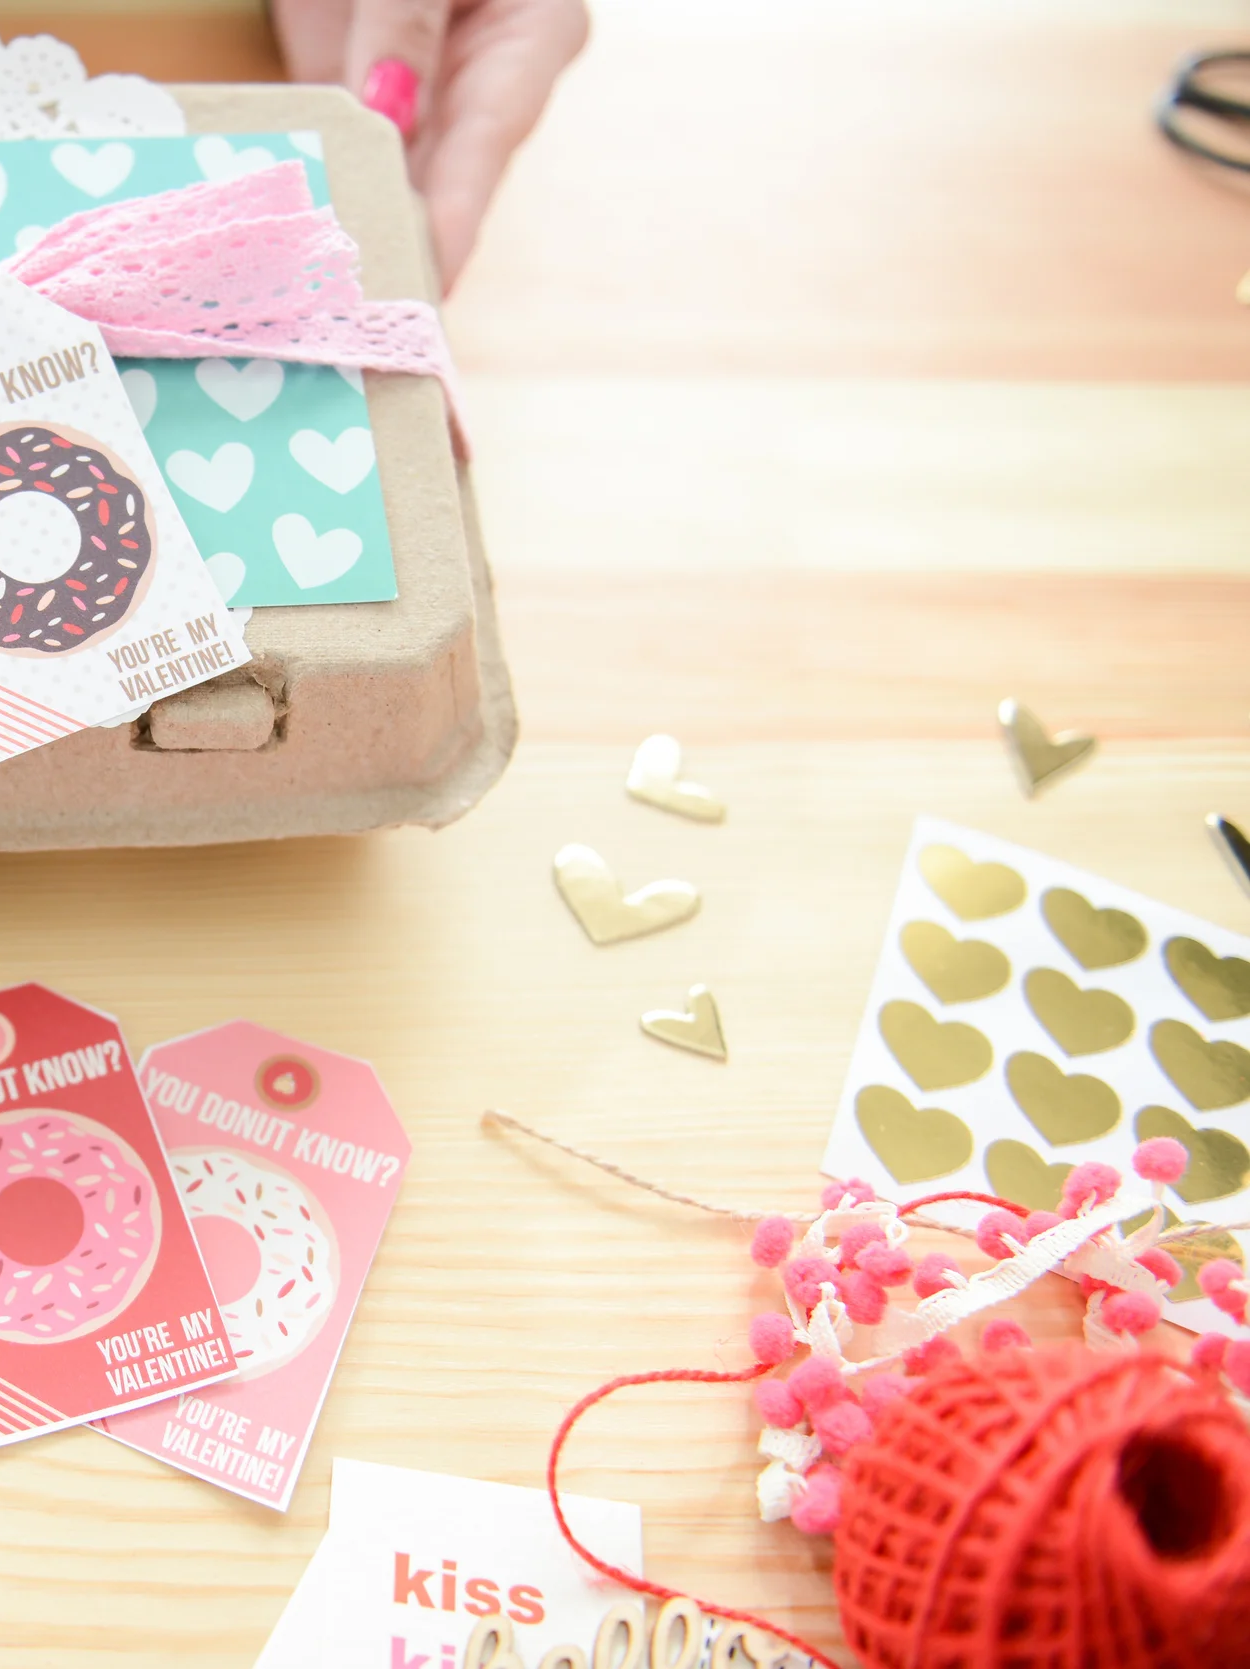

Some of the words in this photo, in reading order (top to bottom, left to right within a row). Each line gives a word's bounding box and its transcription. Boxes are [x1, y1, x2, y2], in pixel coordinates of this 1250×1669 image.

[106, 628, 181, 673] YOU'RE
[185, 613, 218, 645] MY
[118, 640, 235, 702] VALENTINE!
[21, 1039, 122, 1096] KNOW?
[146, 1067, 201, 1115] YOU
[197, 1091, 295, 1152] DONUT
[292, 1127, 400, 1188] KNOW?
[96, 1322, 174, 1365] YOU'RE
[179, 1308, 214, 1341] MY
[105, 1337, 230, 1396] VALENTINE!
[162, 1421, 285, 1493] VALENTINE!
[175, 1393, 252, 1445] YOU'RE
[255, 1425, 296, 1460] MY
[392, 1551, 545, 1625] kiss
